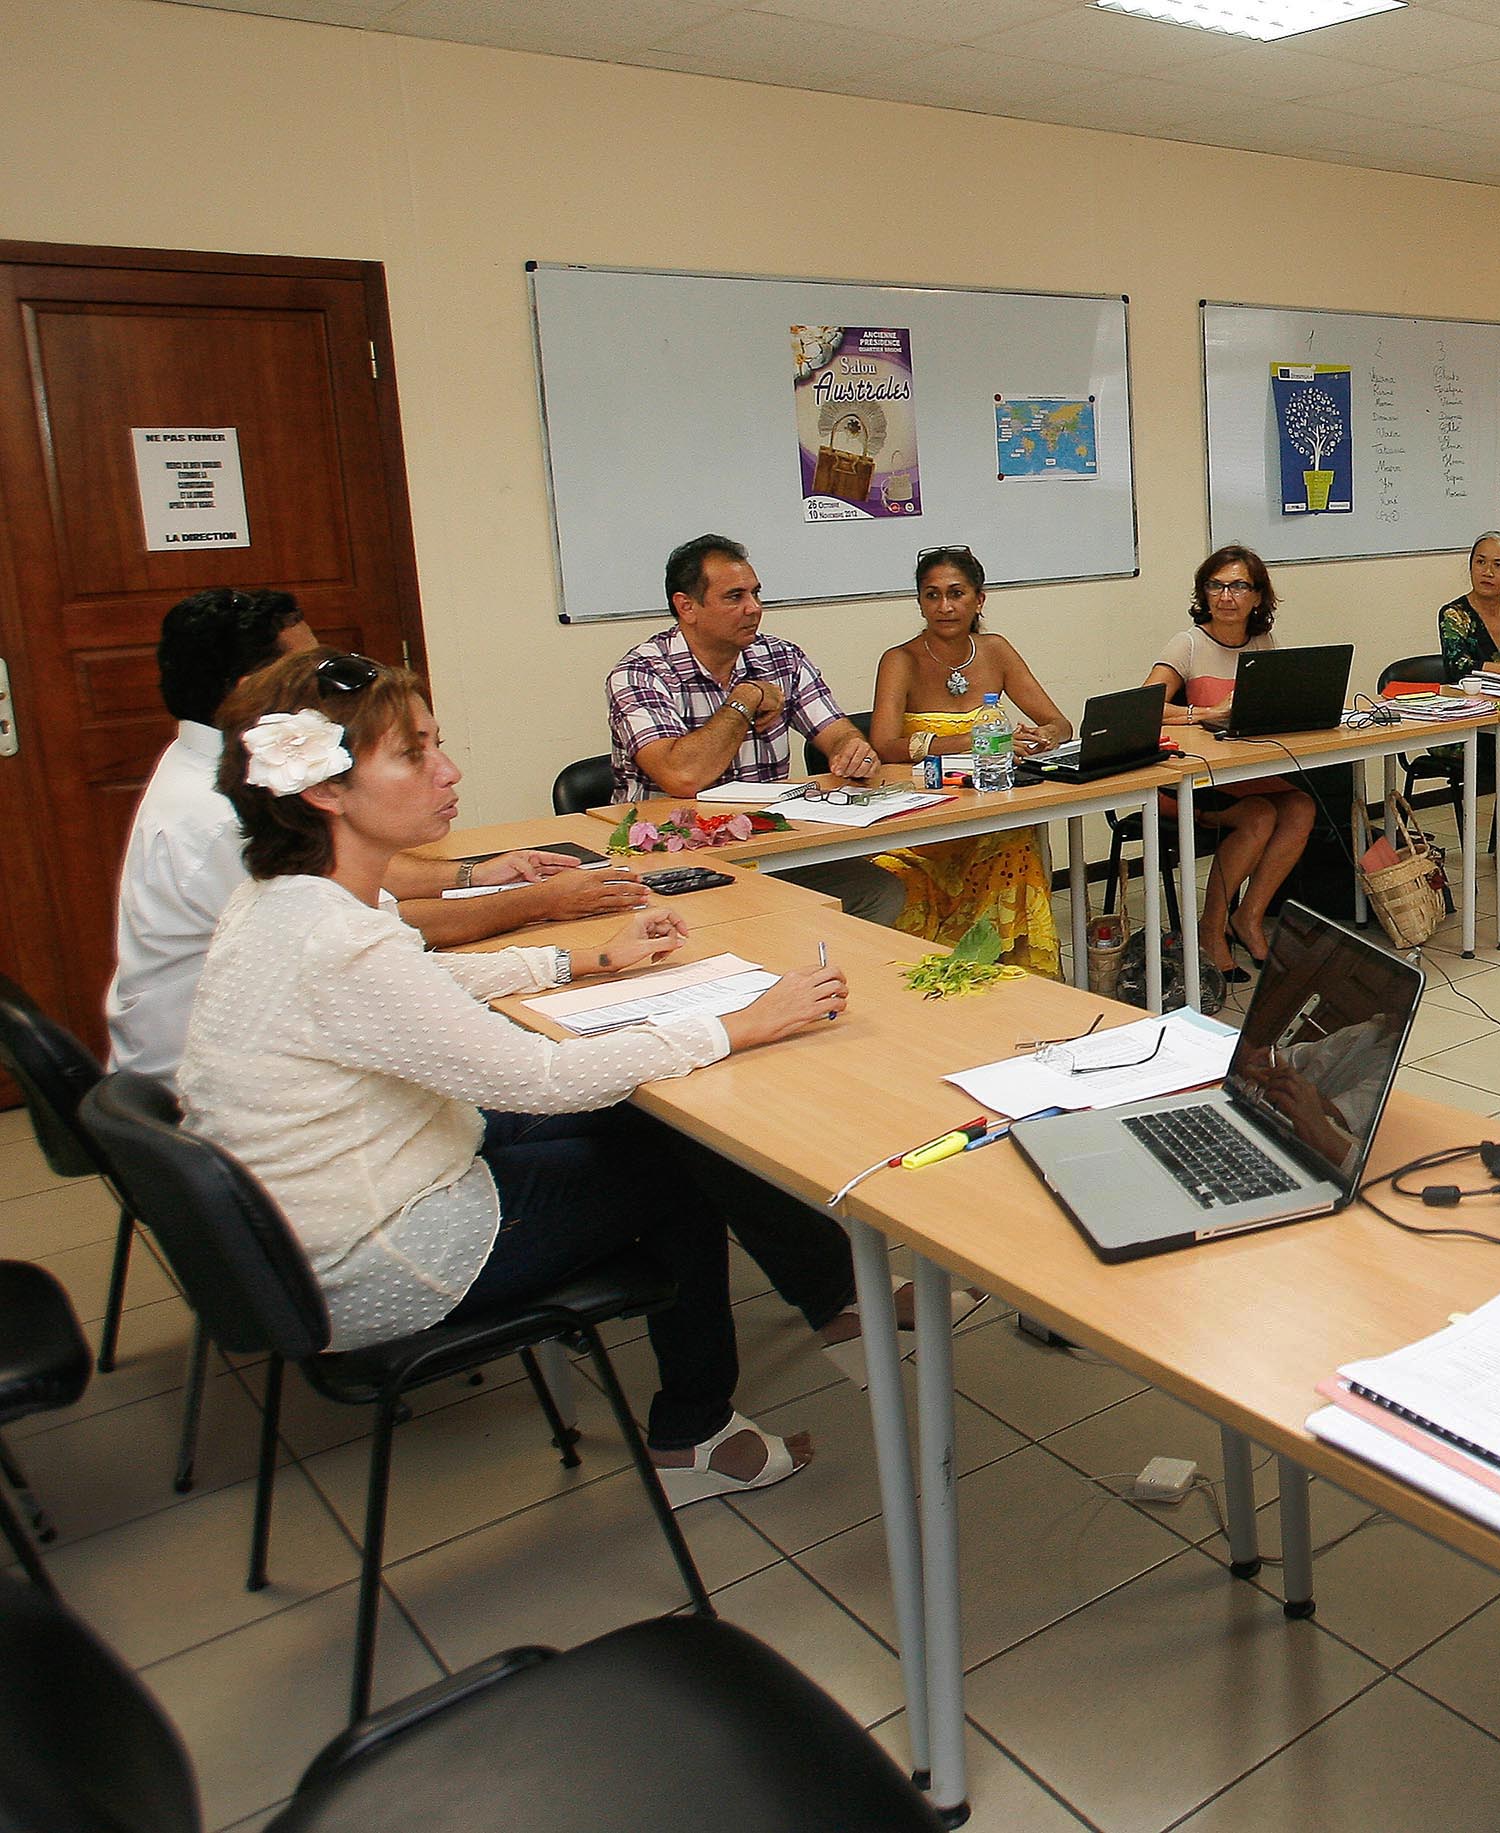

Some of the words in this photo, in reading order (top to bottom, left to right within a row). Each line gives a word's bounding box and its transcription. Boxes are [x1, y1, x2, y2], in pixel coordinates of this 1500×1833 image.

[863, 331, 897, 339] ANCIENNE
[840, 357, 877, 375] Salon
[813, 371, 912, 405] Australes
[145, 434, 161, 442] NE
[163, 434, 186, 442] PAS
[188, 434, 226, 442] FUMER
[809, 510, 818, 519] 10
[165, 534, 180, 543] LA
[181, 532, 237, 542] DIRECTION
